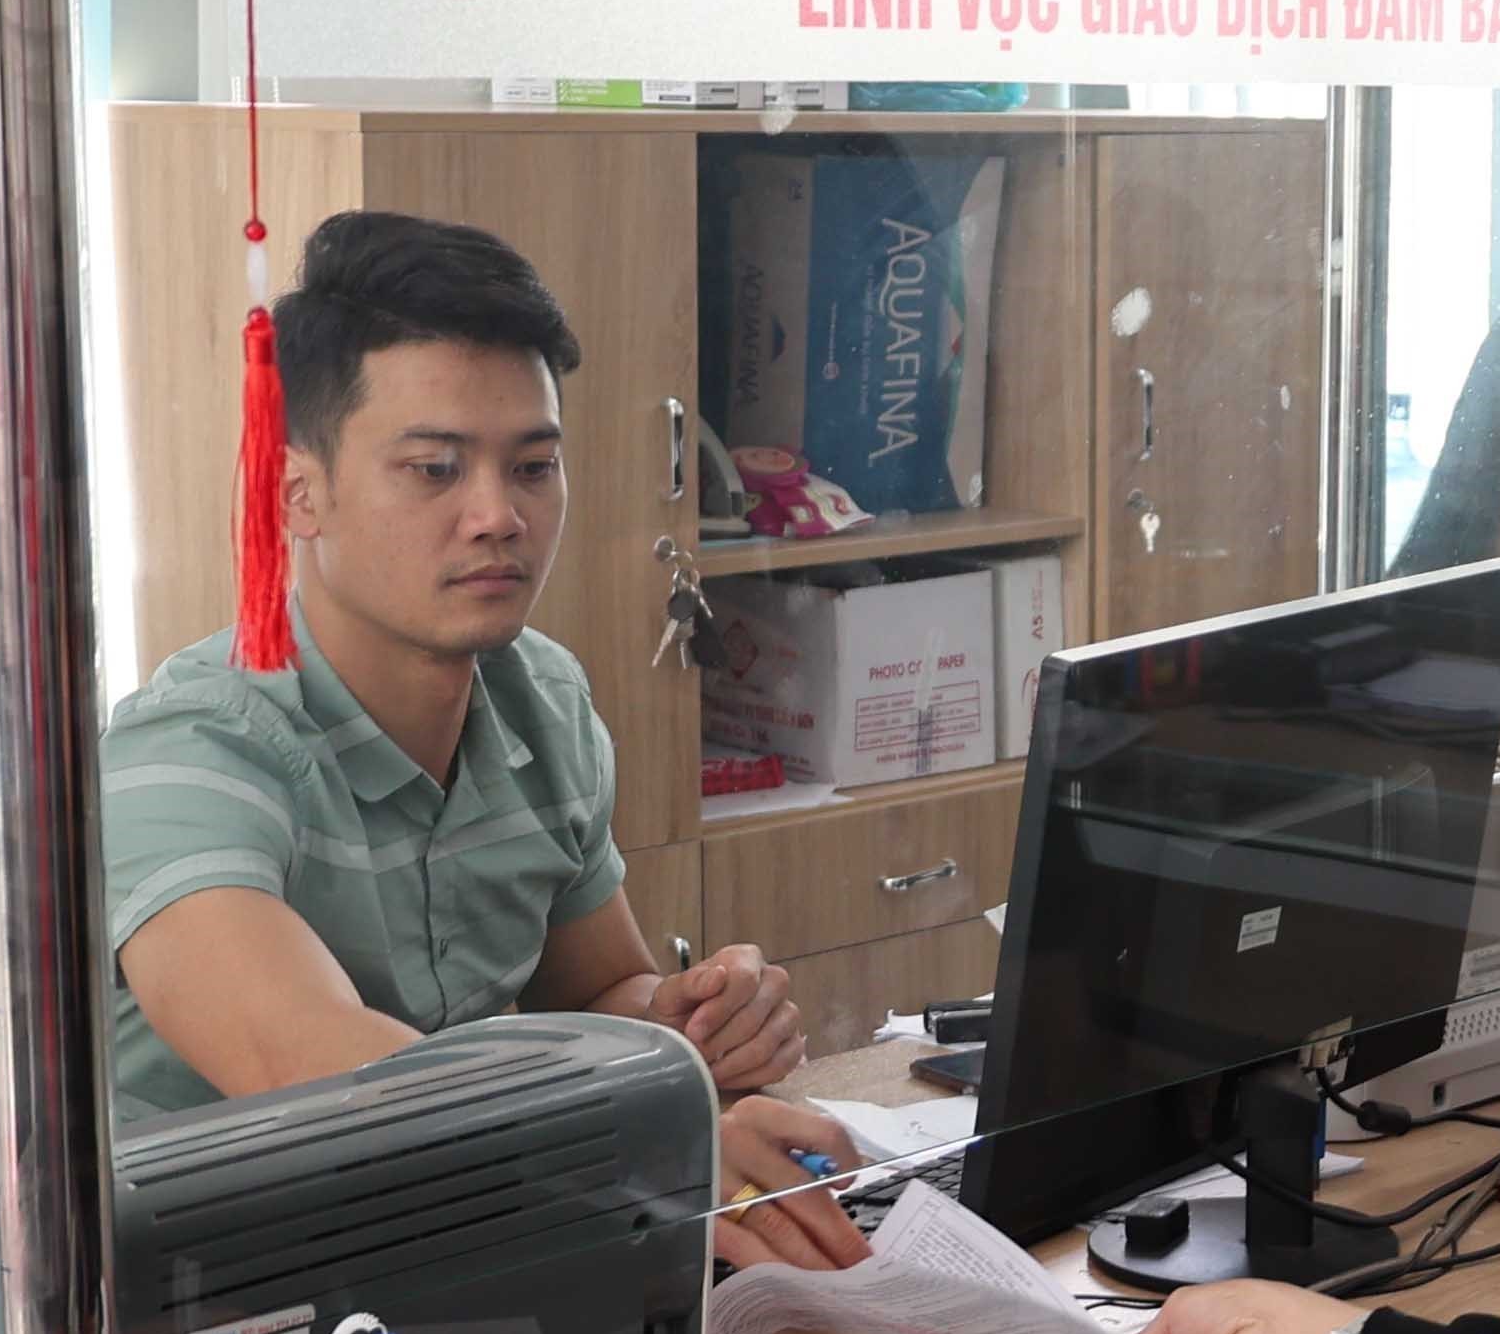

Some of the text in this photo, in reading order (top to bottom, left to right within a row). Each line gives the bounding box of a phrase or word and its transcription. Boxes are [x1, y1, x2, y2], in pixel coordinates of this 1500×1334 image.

[869, 216, 932, 465] AQUAFINA
[868, 662, 906, 682] PHOTO
[937, 652, 966, 671] PAPER
